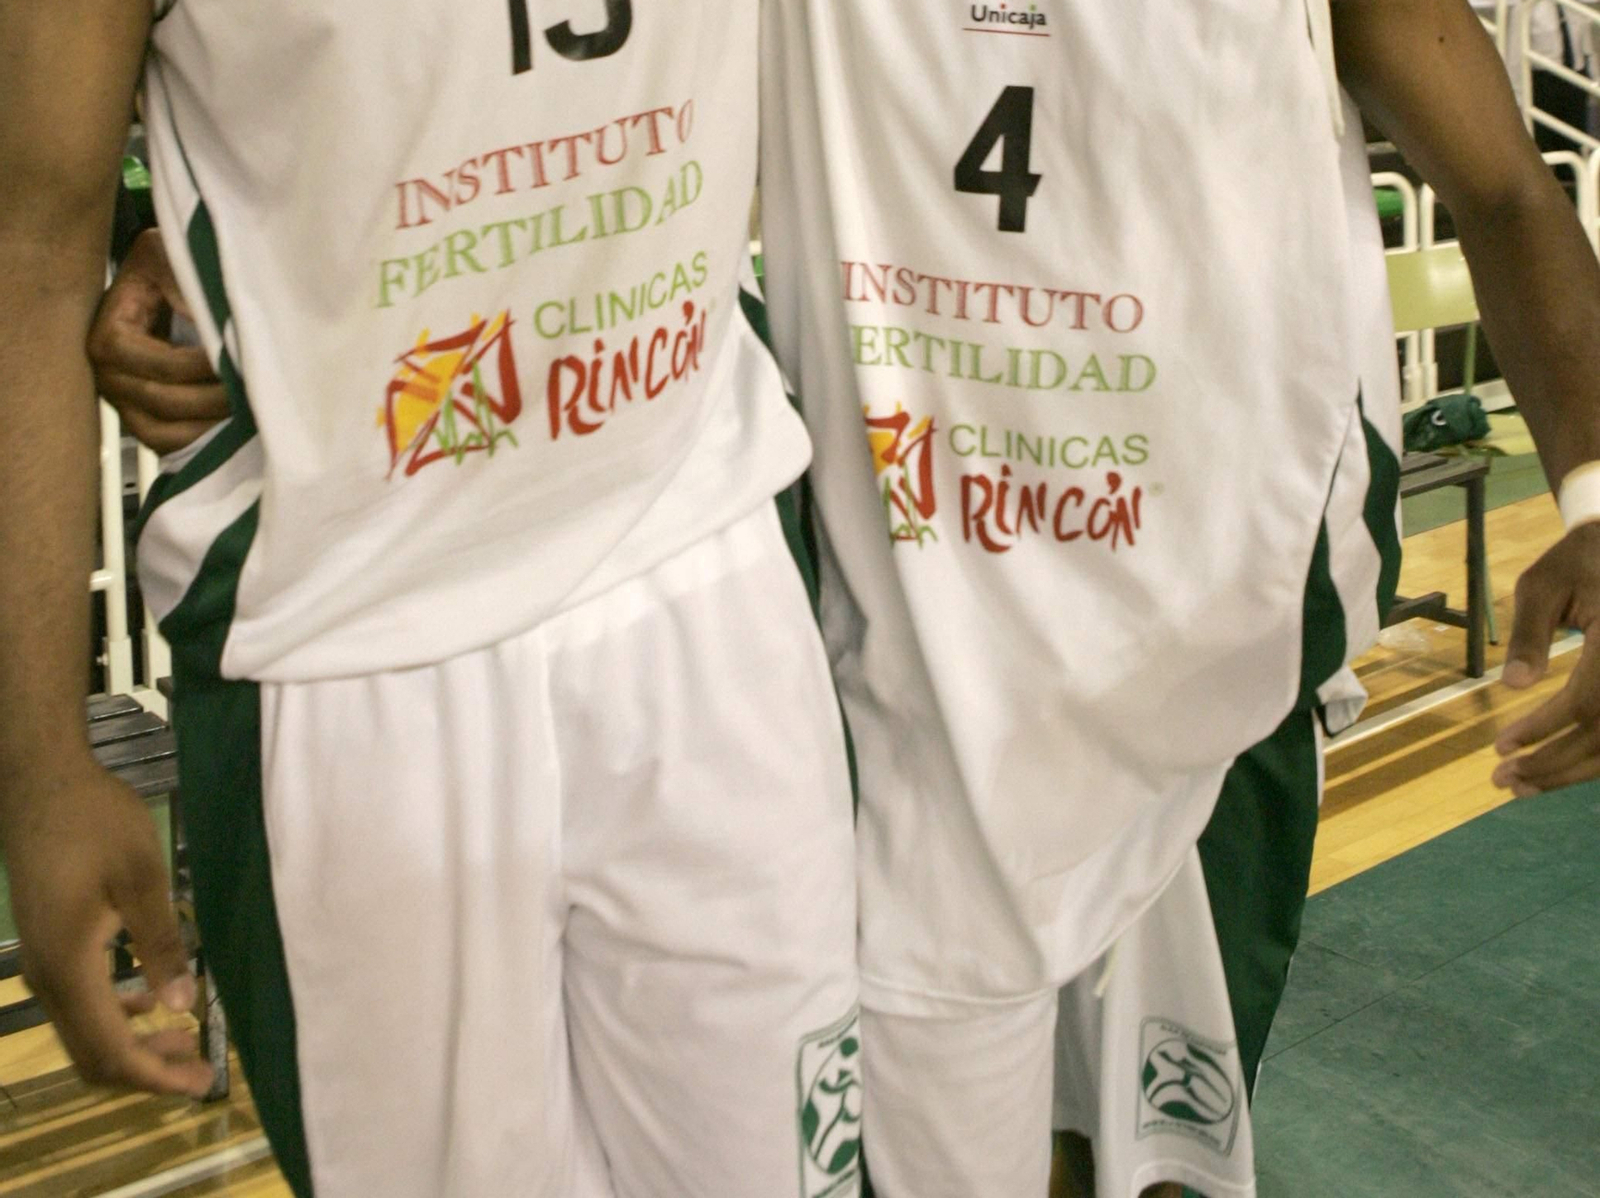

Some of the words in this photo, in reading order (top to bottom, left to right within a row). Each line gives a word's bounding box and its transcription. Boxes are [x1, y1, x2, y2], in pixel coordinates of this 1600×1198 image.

[971, 3, 1047, 29] Unicaja
[394, 99, 694, 230] INSTITUTO
[954, 85, 1042, 233] 4
[376, 160, 704, 308] FERTILIDAD
[534, 250, 709, 340] CLINICAS
[840, 261, 1144, 333] INSTITUTO
[851, 325, 1157, 392] ERTILIDAD
[950, 424, 1150, 469] CLINICAS
